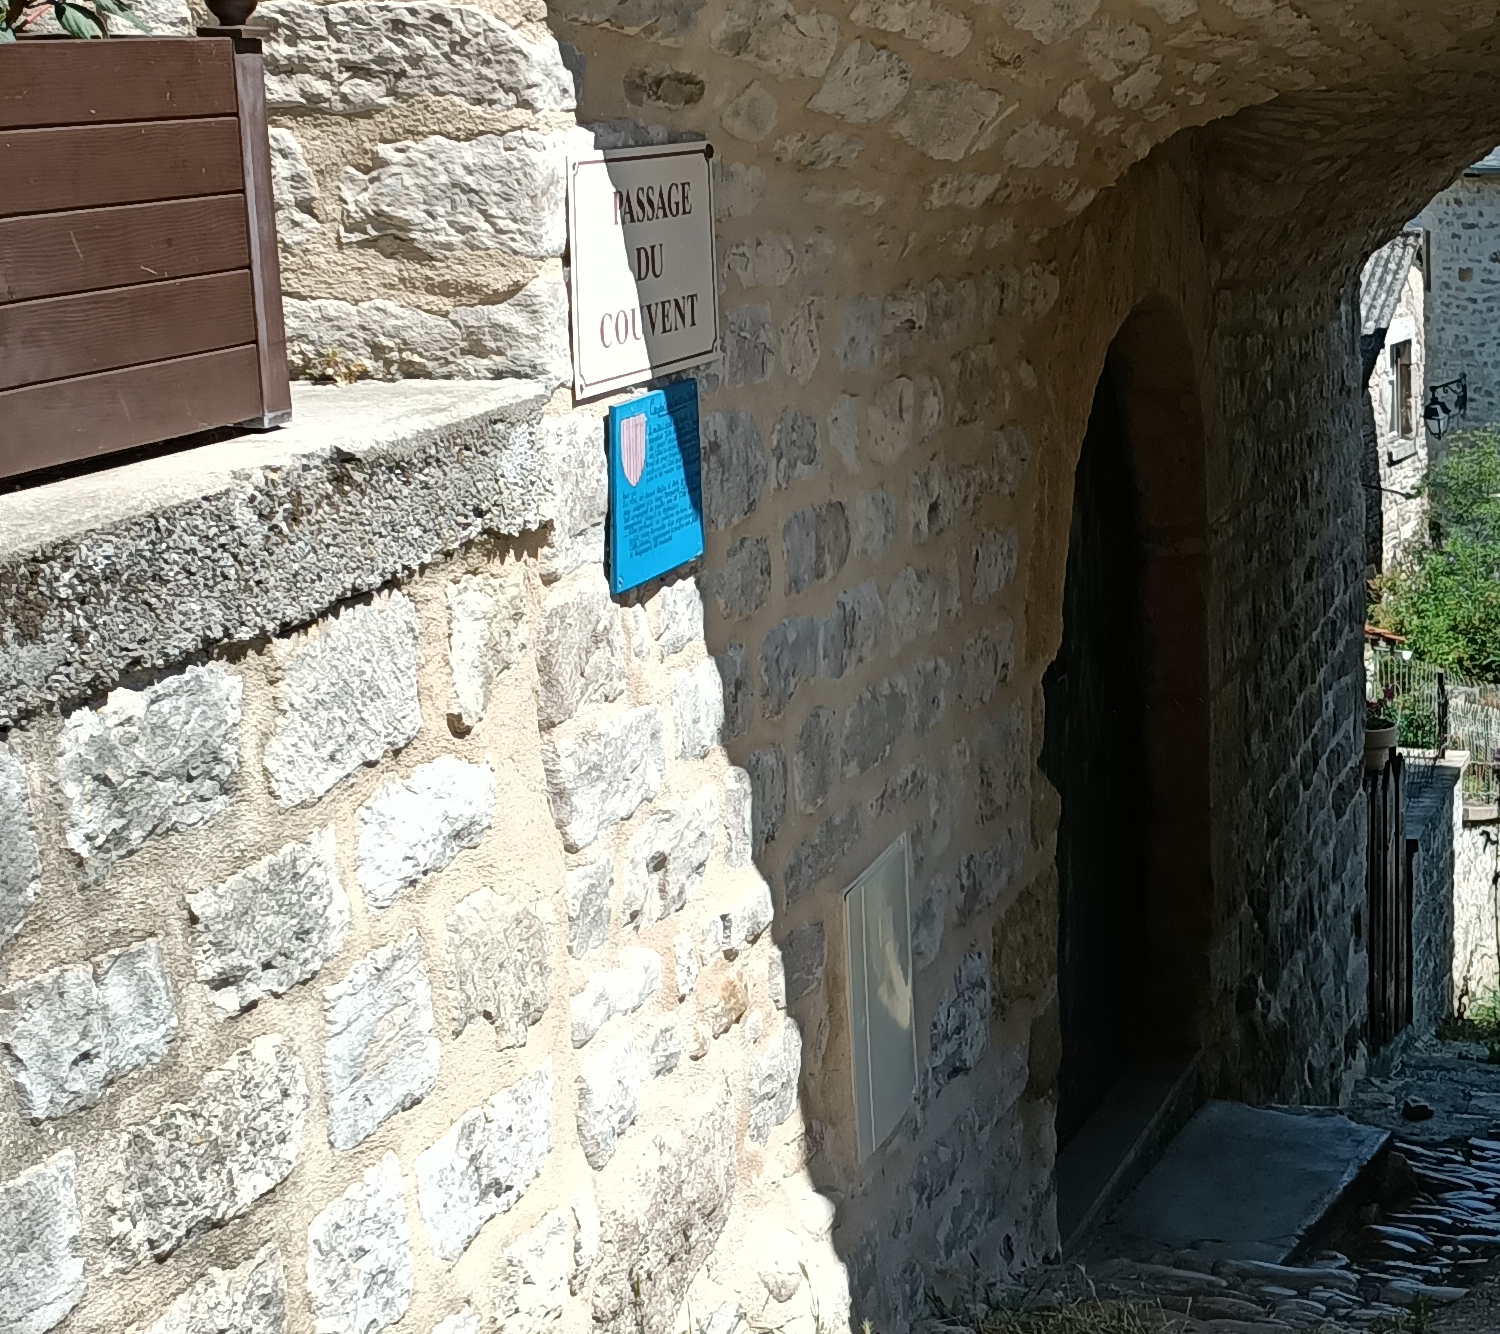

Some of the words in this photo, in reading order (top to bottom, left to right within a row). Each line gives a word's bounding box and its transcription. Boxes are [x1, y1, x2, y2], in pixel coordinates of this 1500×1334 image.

[613, 181, 693, 225] PASSAGE
[635, 243, 664, 282] DU
[600, 293, 699, 349] COUVENT
